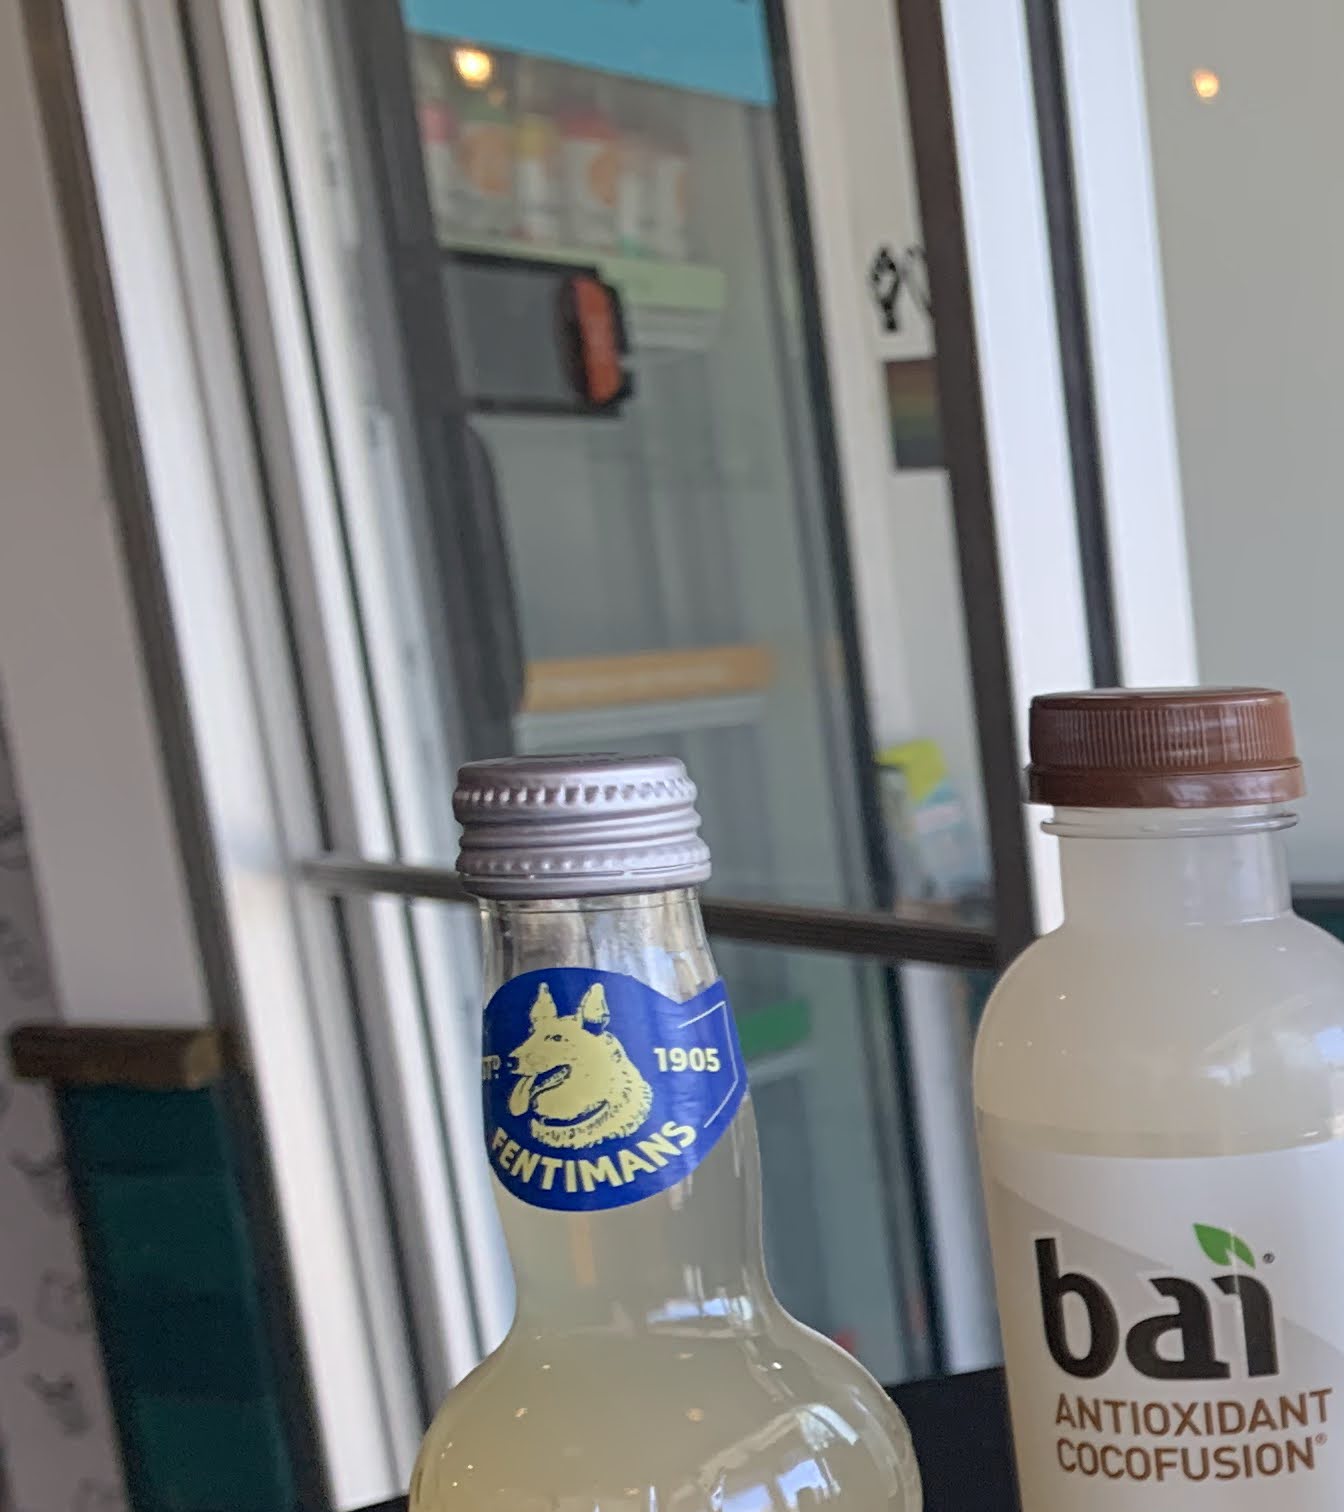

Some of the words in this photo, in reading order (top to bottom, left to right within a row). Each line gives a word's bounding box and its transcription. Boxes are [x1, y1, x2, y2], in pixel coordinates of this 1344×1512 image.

[654, 1047, 720, 1072] 1905
[491, 1120, 696, 1192] FENTIMANS
[1035, 1235, 1280, 1381] bai
[1056, 1388, 1333, 1436] ANTIOXIDANT
